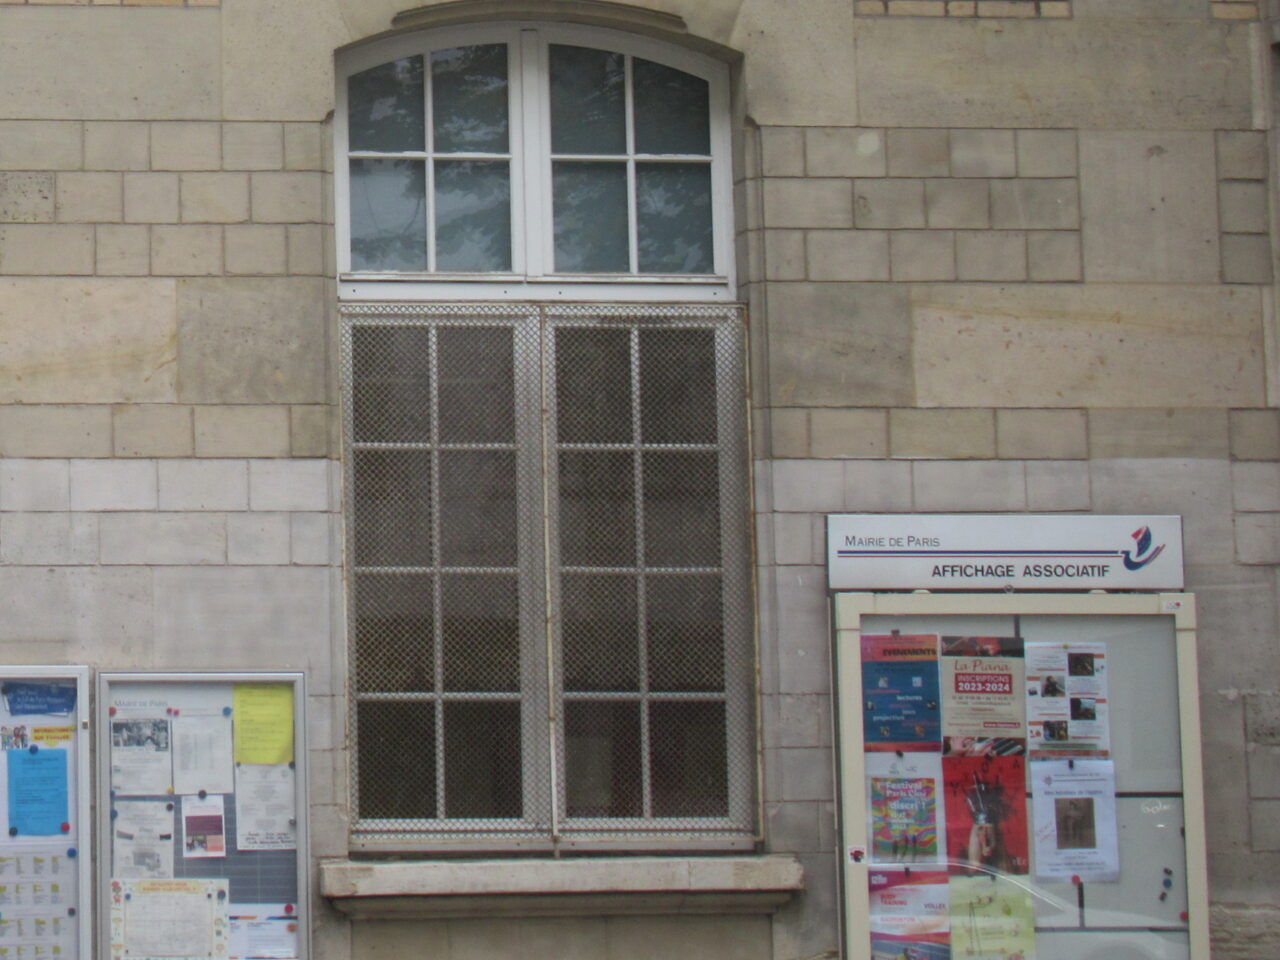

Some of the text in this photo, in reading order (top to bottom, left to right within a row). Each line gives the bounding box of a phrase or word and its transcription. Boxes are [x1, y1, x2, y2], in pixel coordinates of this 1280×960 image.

[931, 564, 1111, 578] AFFICHAGE ASSOCIATIF
[958, 674, 1010, 683] INSCRIPTIONS
[958, 683, 1011, 692] 2023-2024
